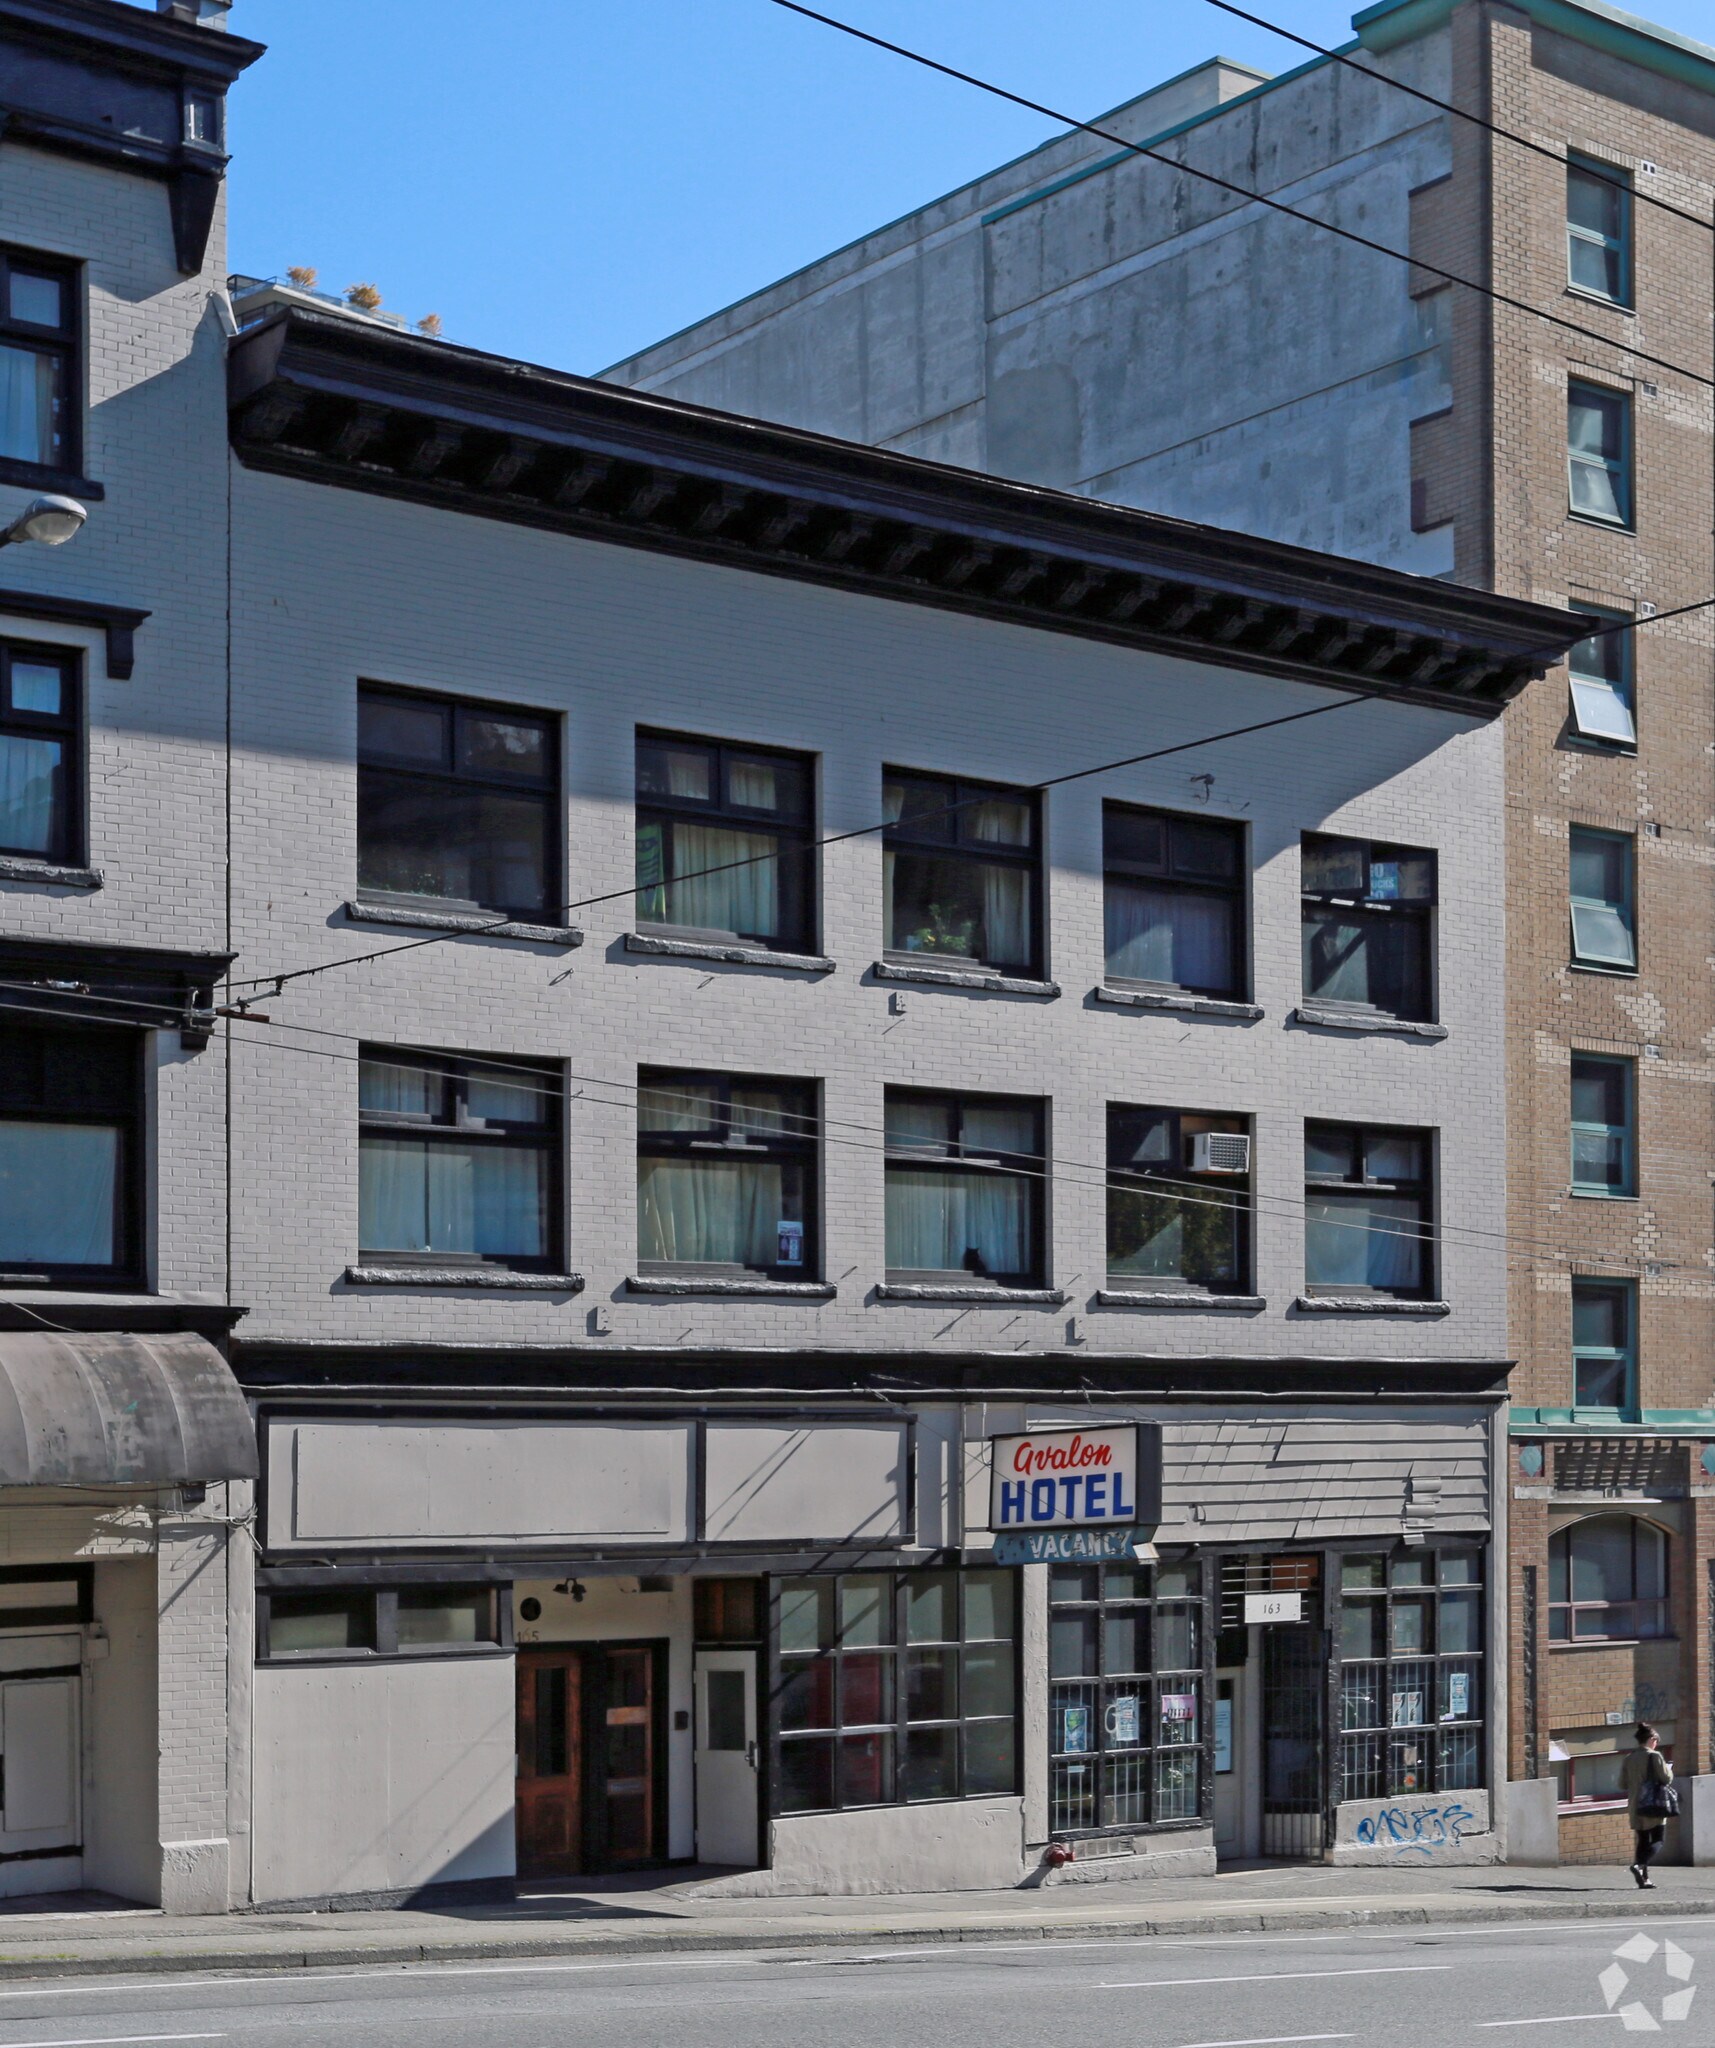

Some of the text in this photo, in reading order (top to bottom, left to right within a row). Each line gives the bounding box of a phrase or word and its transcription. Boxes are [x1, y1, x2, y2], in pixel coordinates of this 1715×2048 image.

[1001, 1472, 1133, 1523] HOTEL
[1028, 1530, 1132, 1559] VACANCY
[1263, 1603, 1281, 1614] 163
